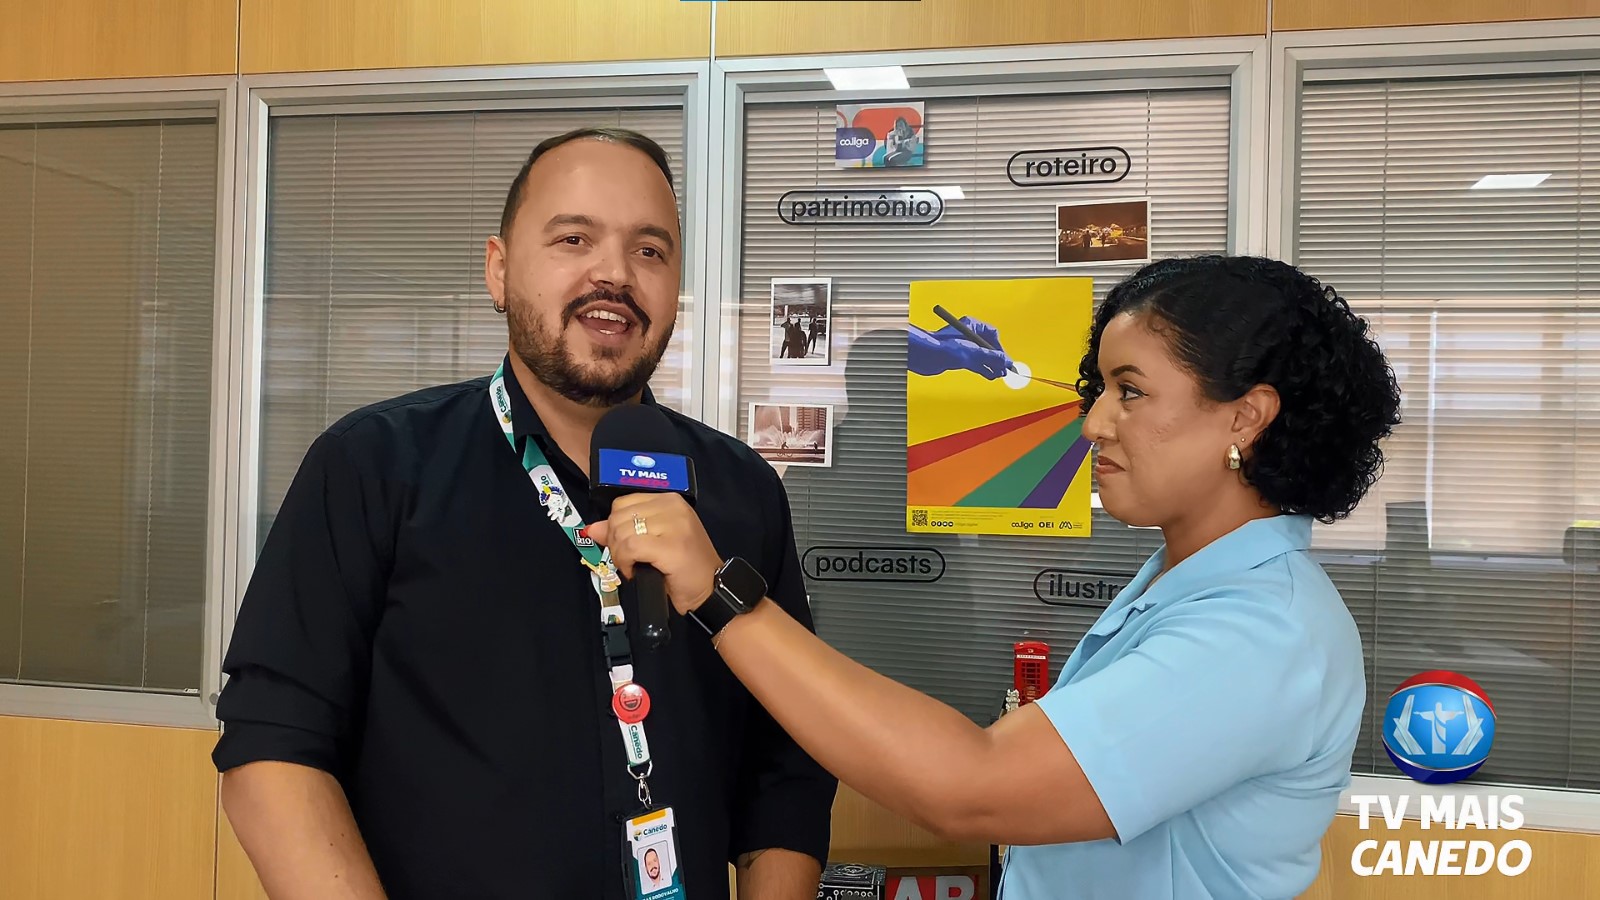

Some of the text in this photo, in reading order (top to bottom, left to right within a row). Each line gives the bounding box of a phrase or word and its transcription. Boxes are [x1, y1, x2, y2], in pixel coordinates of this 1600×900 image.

[1025, 152, 1117, 178] roteiro
[791, 194, 932, 222] patrimônio
[619, 468, 668, 480] TV MAIS
[815, 551, 932, 577] podcasts
[1048, 573, 1127, 601] ilustr
